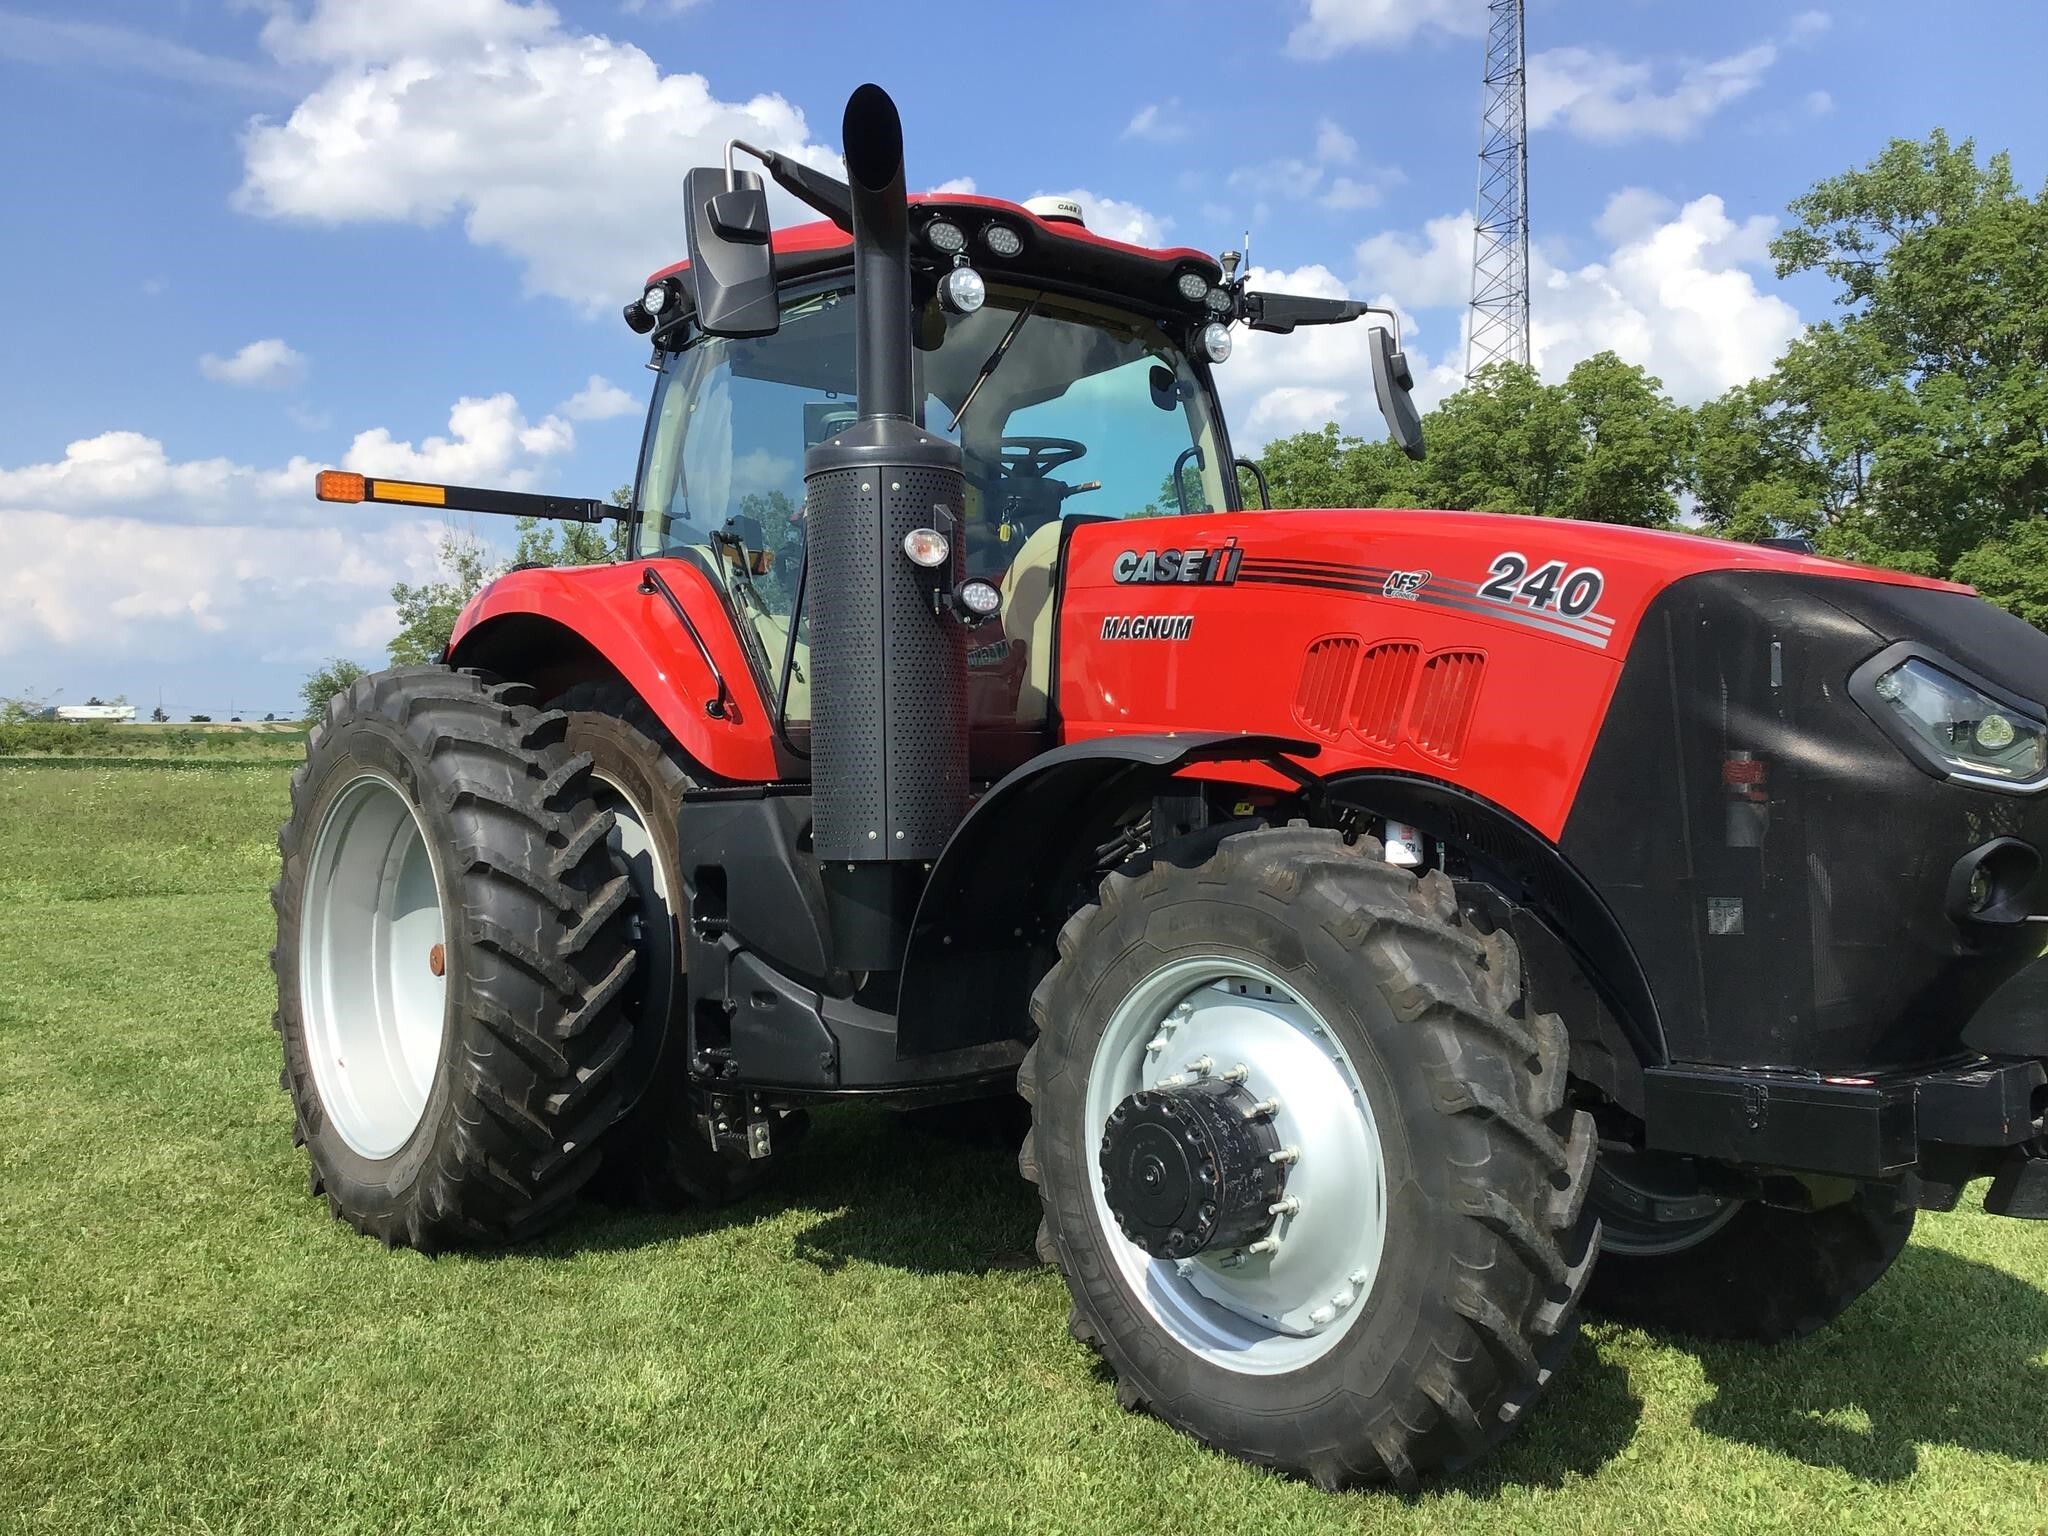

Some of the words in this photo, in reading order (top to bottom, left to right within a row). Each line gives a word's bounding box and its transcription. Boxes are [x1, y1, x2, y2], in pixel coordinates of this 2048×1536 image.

[1058, 204, 1077, 213] CASE
[1112, 549, 1206, 585] CASE
[1383, 571, 1421, 591] AFS
[1476, 551, 1604, 619] 240
[1101, 615, 1194, 640] MAGNUM
